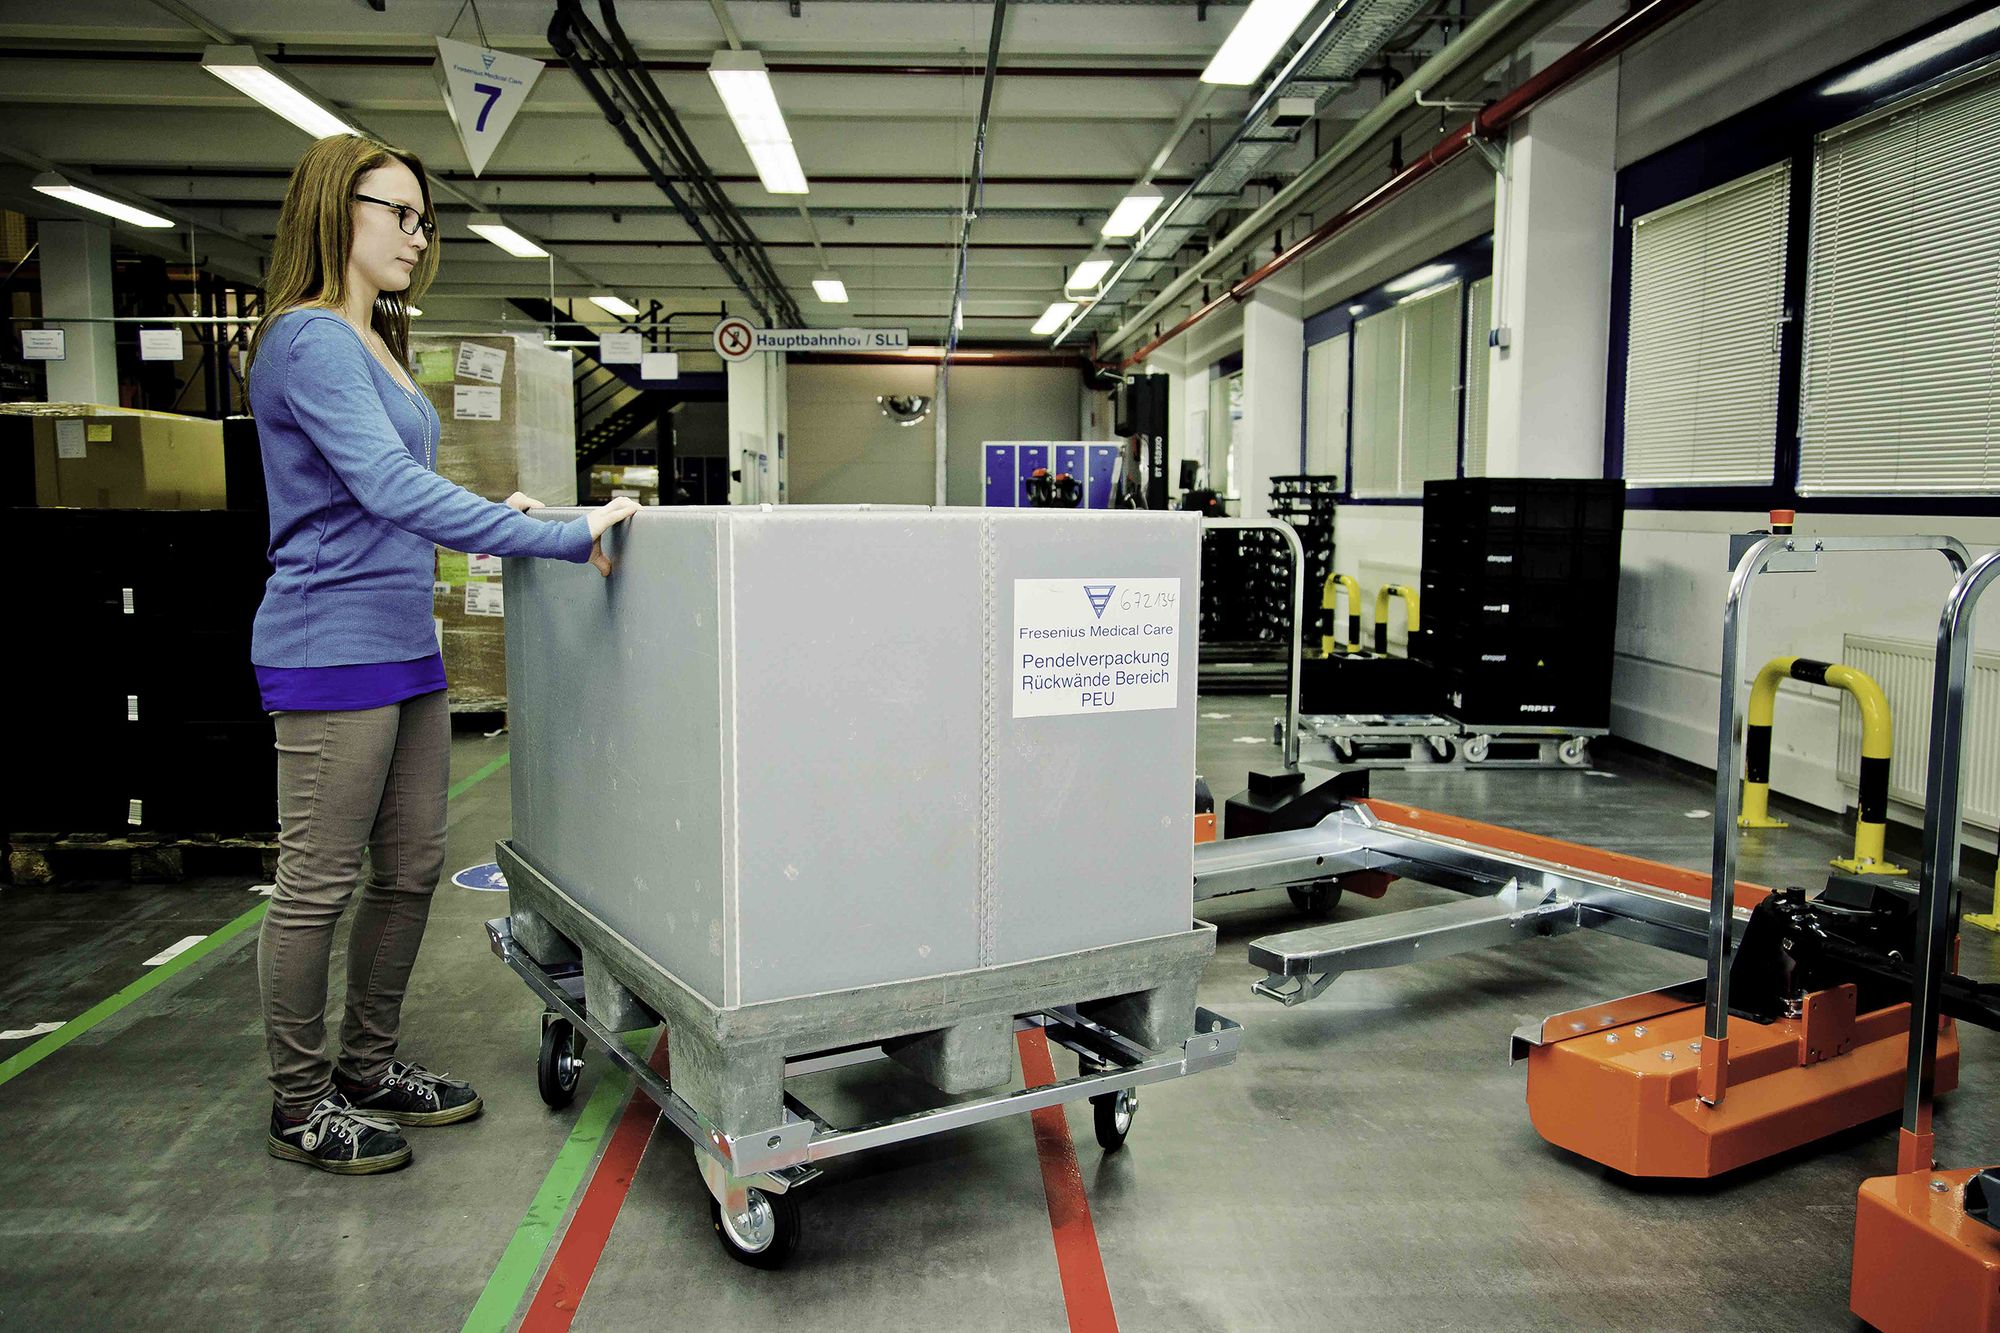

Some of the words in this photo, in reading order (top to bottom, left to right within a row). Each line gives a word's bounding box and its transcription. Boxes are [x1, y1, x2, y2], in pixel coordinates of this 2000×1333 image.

[474, 82, 502, 132] 7
[875, 333, 904, 346] SLL
[1019, 627, 1086, 639] Fresenius
[1090, 625, 1139, 637] Medical
[1143, 624, 1174, 635] Care
[1022, 650, 1170, 669] Pendelverpackung
[1022, 672, 1110, 690] Rückwände
[1116, 670, 1170, 686] Bereich
[1081, 691, 1115, 707] PEU
